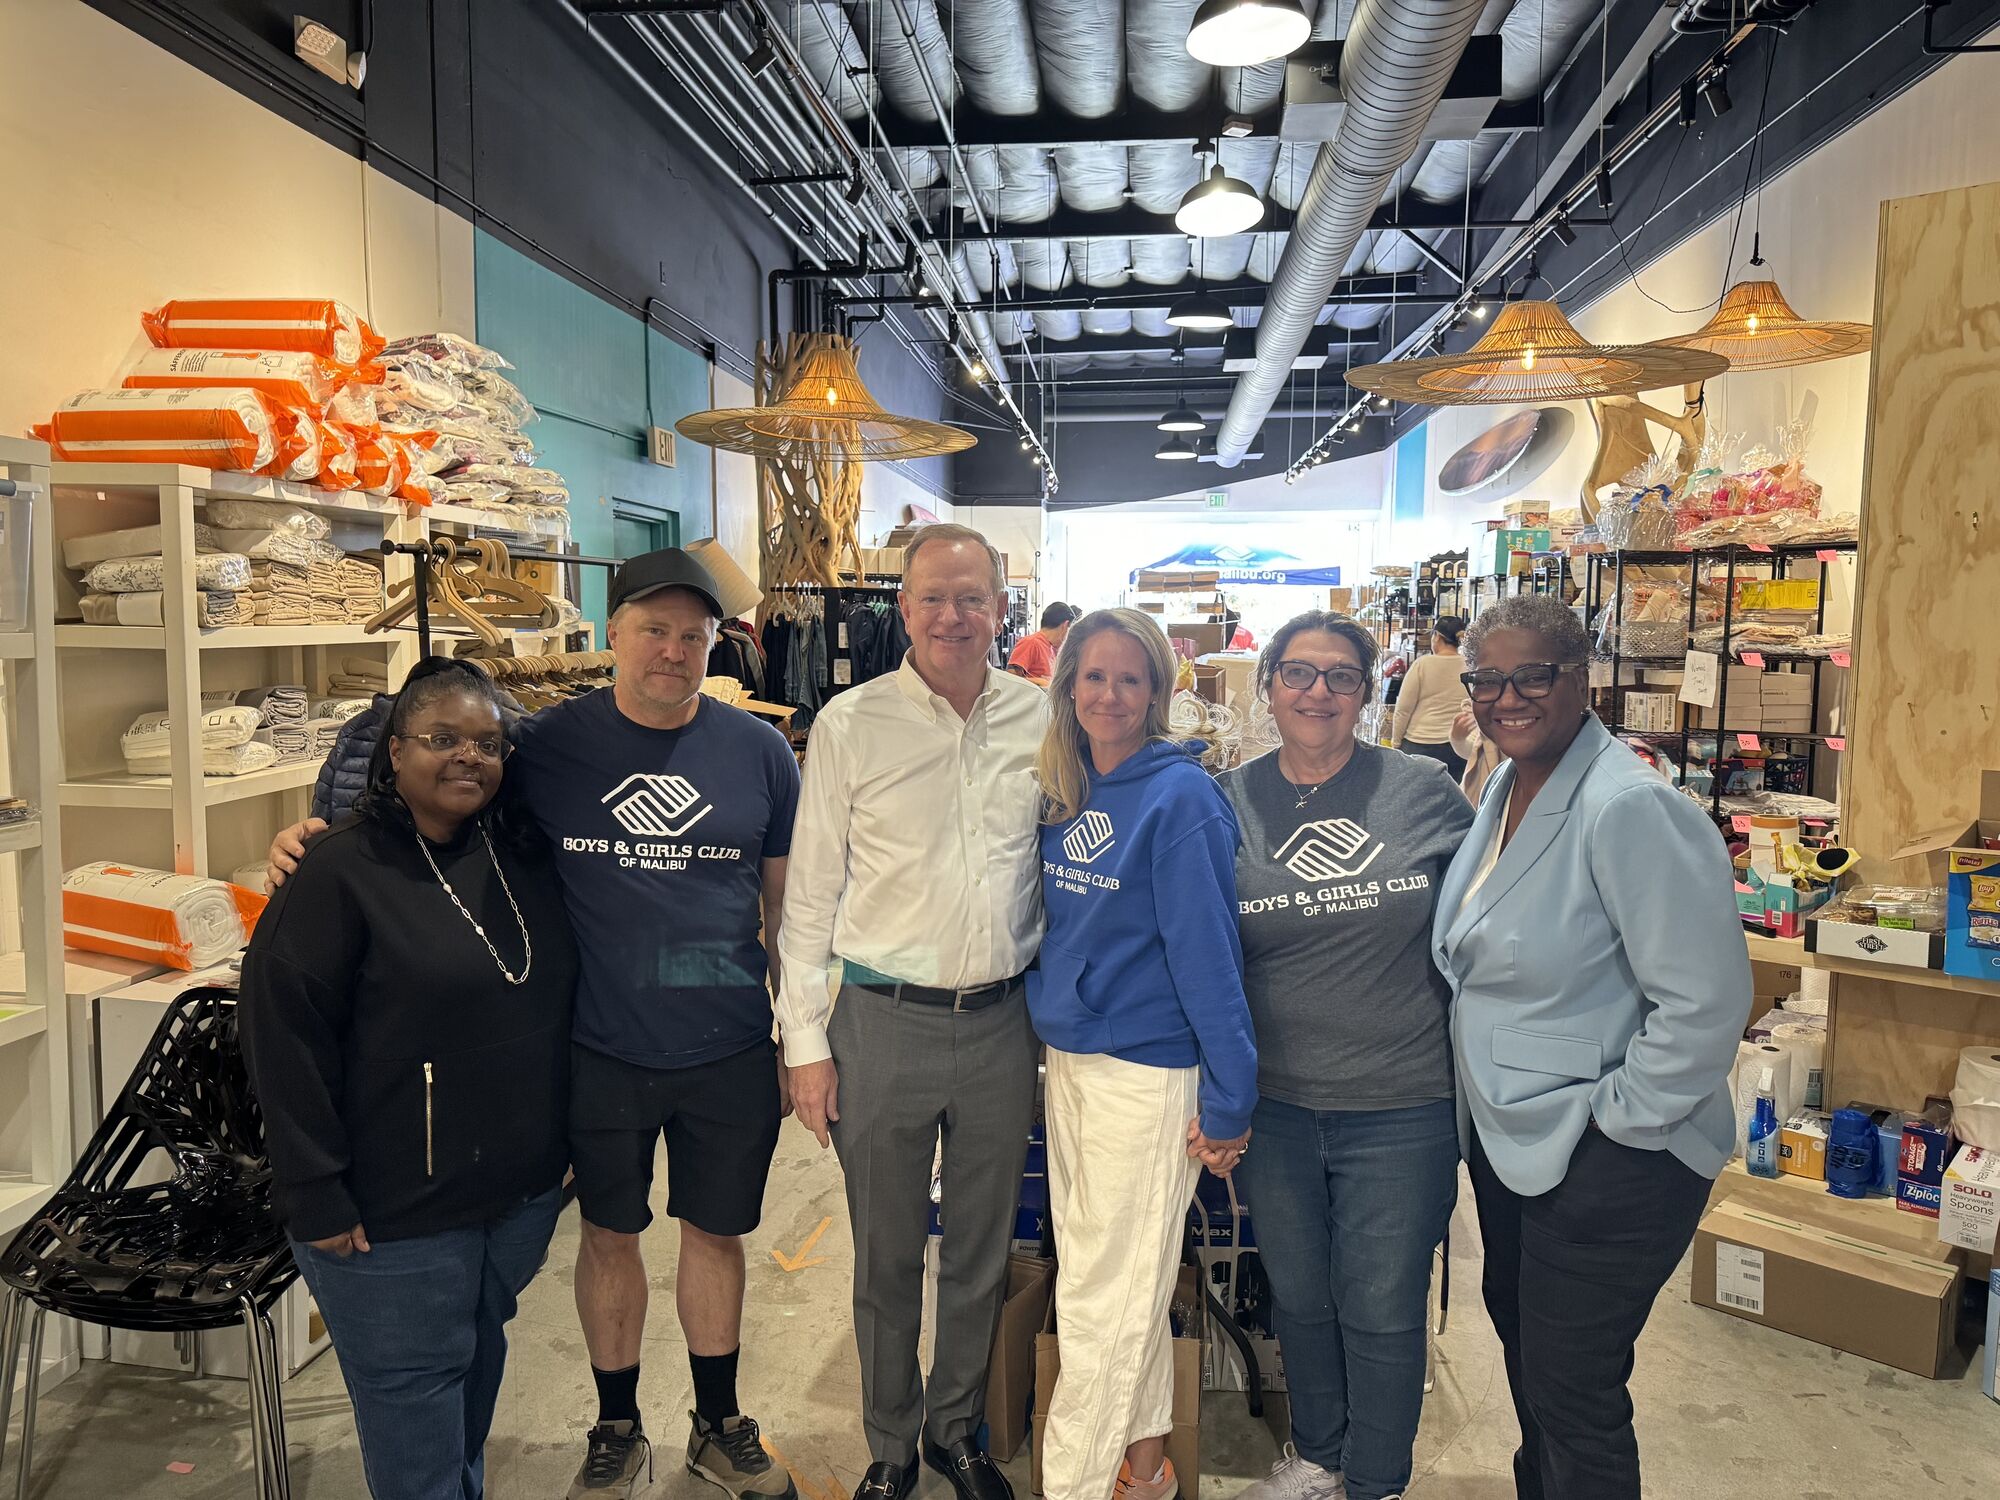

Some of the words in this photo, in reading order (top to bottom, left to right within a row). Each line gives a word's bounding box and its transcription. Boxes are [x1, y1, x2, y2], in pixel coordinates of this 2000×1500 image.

[1209, 495, 1225, 507] EXIT
[1734, 820, 1746, 828] 33
[563, 837, 609, 853] BOYS
[613, 841, 630, 855] &
[634, 843, 692, 857] GIRLS
[697, 846, 741, 860] CLUB
[619, 857, 637, 868] OF
[640, 858, 687, 870] MALIBU
[1056, 865, 1064, 877] &
[1065, 867, 1090, 884] GIRLS
[1091, 874, 1120, 890] CLUB
[1055, 879, 1064, 889] OF
[1065, 882, 1087, 895] MALIBU
[1238, 894, 1289, 915] BOYS
[1294, 891, 1313, 905] &
[1317, 881, 1380, 902] GIRLS
[1386, 874, 1429, 893] CLUB
[1303, 905, 1322, 917] OF
[1326, 896, 1379, 914] MALIBU
[1860, 941, 1884, 951] STREET
[1862, 937, 1881, 945] FIRST
[1907, 1142, 1917, 1171] STORAGE
[1906, 1185, 1940, 1203] Ziploc
[1953, 1183, 1993, 1198] SOLO
[1949, 1197, 1994, 1216] Spoons
[1950, 1192, 1994, 1206] Heavyweight
[1962, 1221, 1978, 1230] 500
